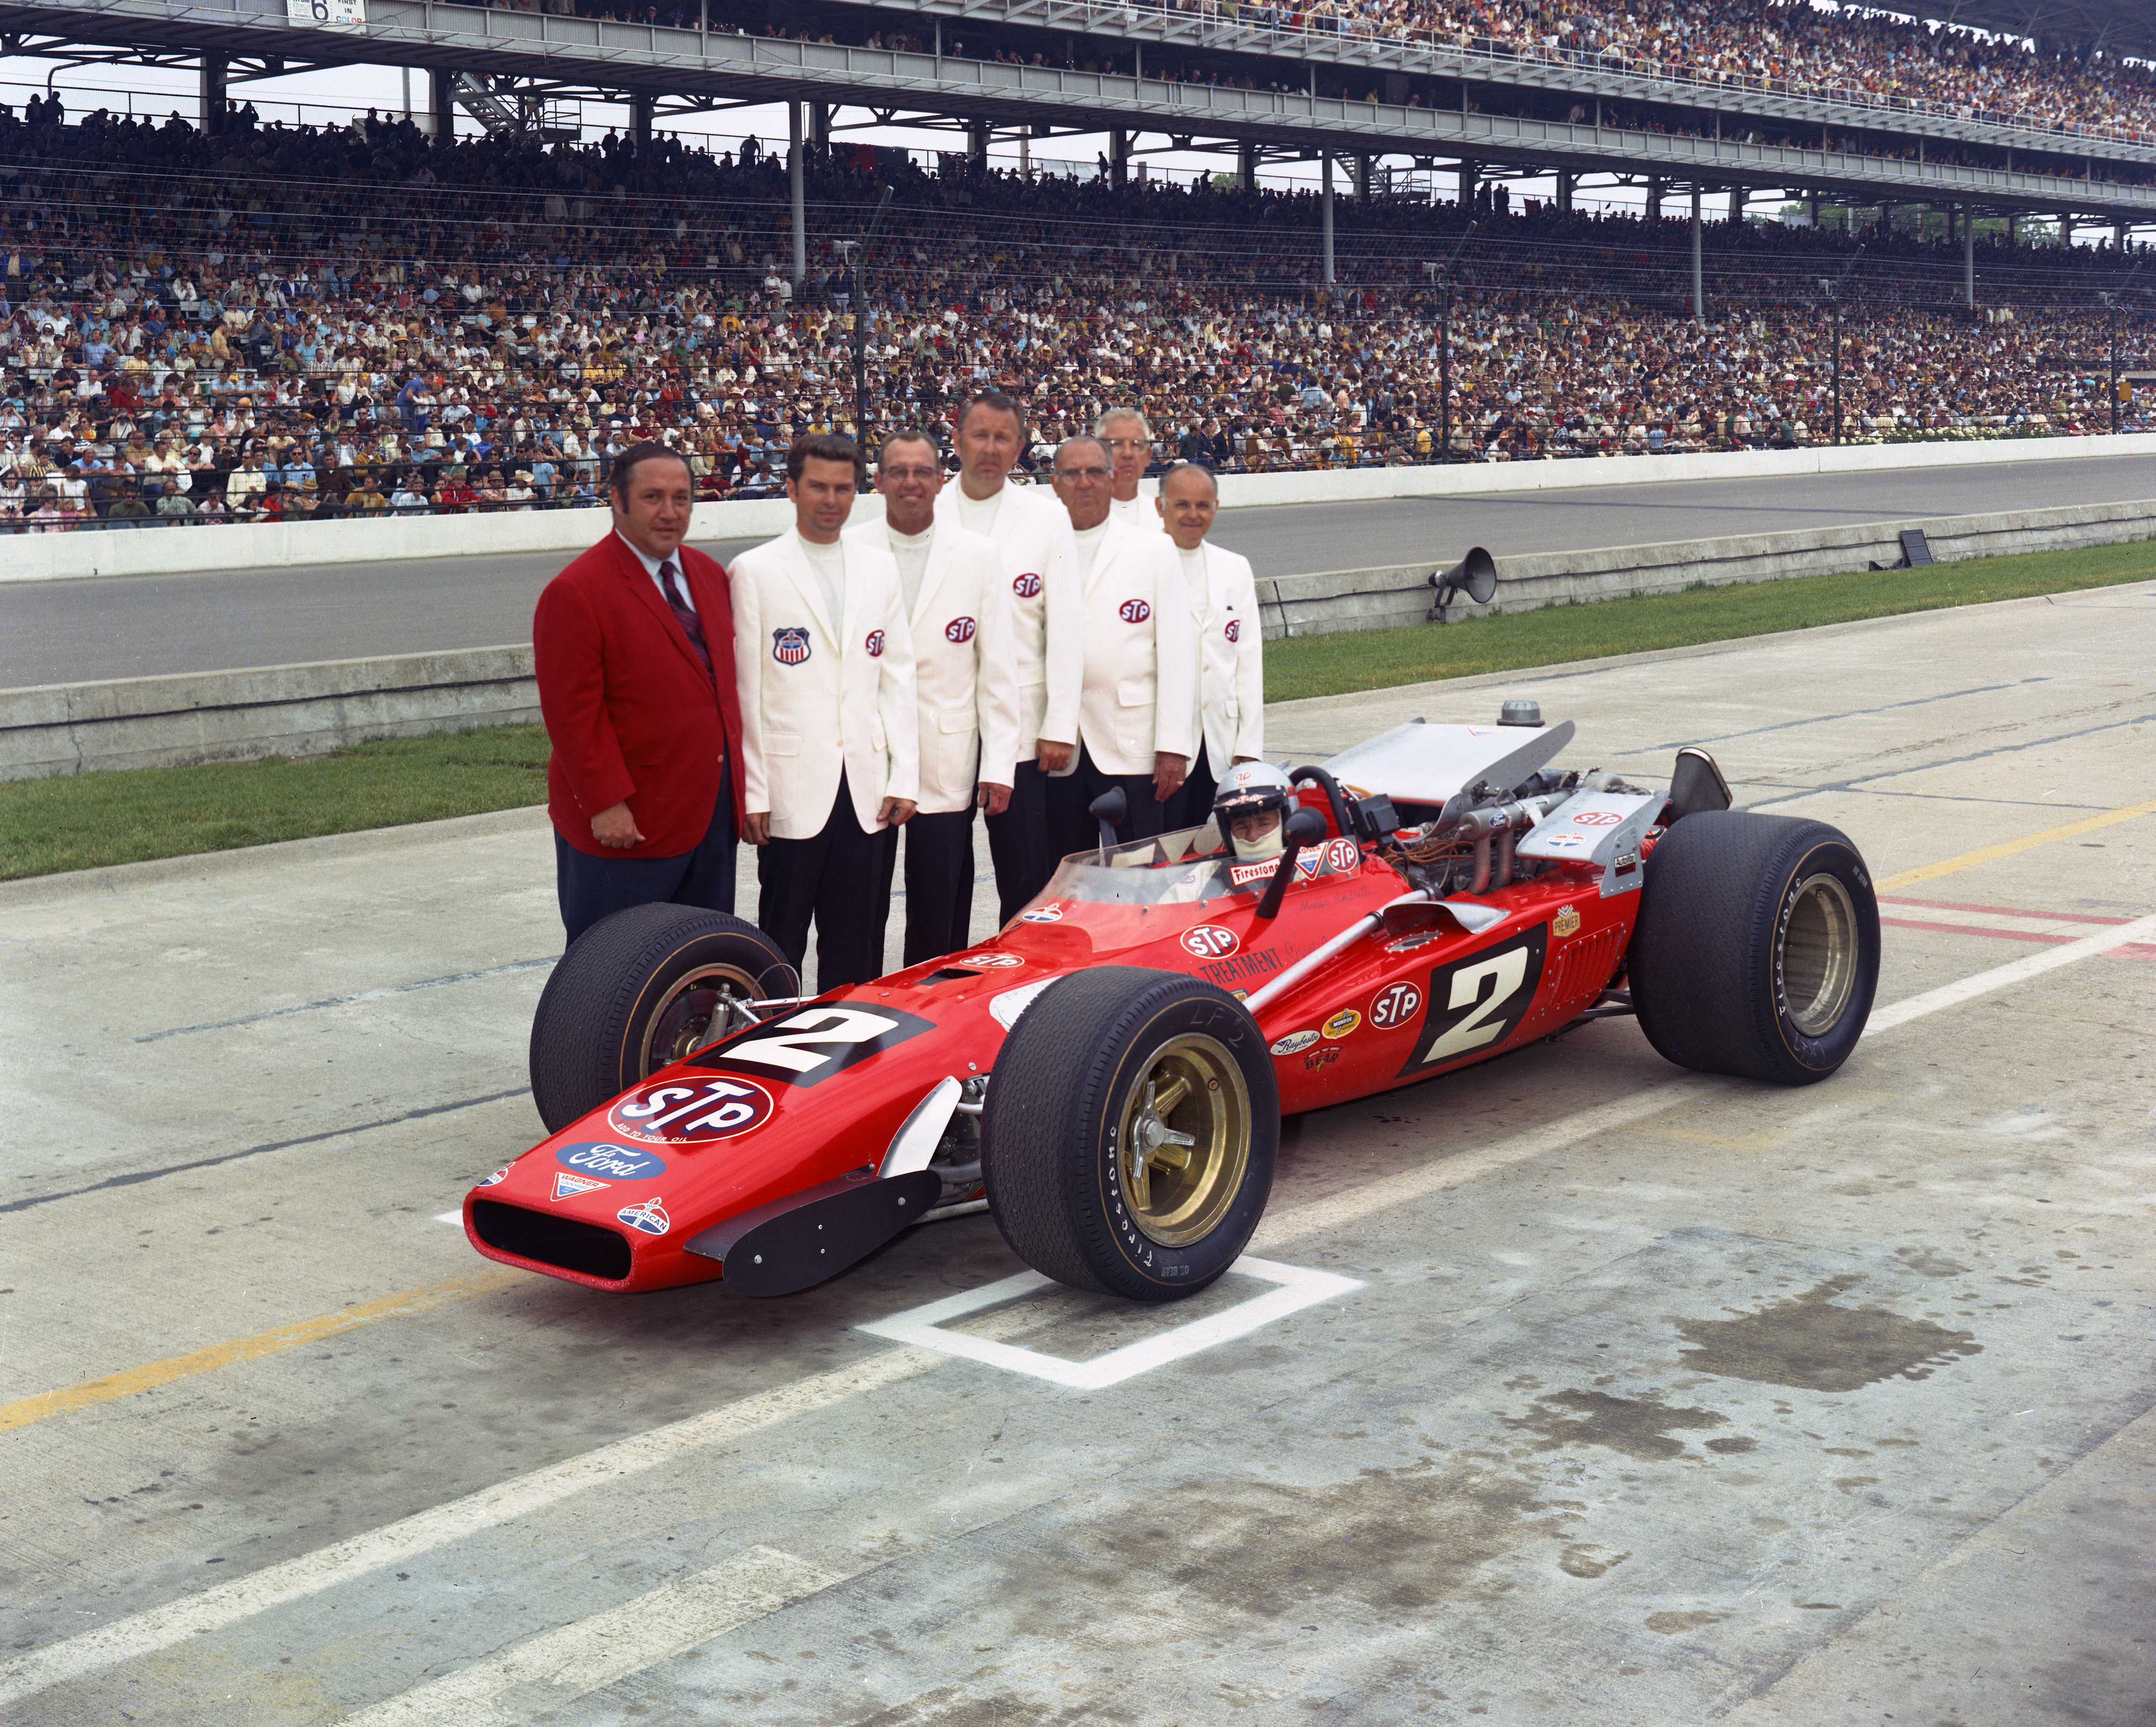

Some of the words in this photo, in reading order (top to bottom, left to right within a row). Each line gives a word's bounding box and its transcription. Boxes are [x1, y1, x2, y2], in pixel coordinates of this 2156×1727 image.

[293, 2, 311, 13] tv
[311, 0, 329, 20] 6
[1015, 574, 1040, 596] STP
[1121, 600, 1149, 622] STP
[948, 618, 975, 641] STP
[1226, 621, 1239, 640] ST
[1493, 814, 1506, 826] Ford
[1574, 813, 1620, 825] STP
[1298, 845, 1321, 854] AGNER
[1331, 842, 1355, 868] STP
[1616, 855, 1635, 867] Autolite
[1234, 863, 1279, 882] Firestone
[1298, 900, 1330, 913] Mario
[1332, 885, 1374, 905] Andretti
[1555, 914, 1578, 934] PREMIER
[1187, 927, 1233, 955] STP
[962, 954, 1019, 966] STP
[1199, 948, 1283, 985] TREATMENT
[1374, 985, 1417, 1024] STP
[1421, 946, 1528, 1064] 2
[1333, 1016, 1353, 1028] MONROE
[719, 1008, 899, 1073] 2
[1278, 1032, 1319, 1053] Raybestos
[1305, 1053, 1339, 1070] BEAR
[619, 1081, 758, 1134] STP
[616, 1123, 630, 1133] ADD
[643, 1134, 668, 1142] YOUR
[568, 1144, 651, 1176] Ford
[560, 1180, 588, 1190] LOCKHEED
[562, 1174, 600, 1187] WAGNER
[621, 1209, 667, 1230] AMERICAN
[1161, 1266, 1179, 1277] BEAR
